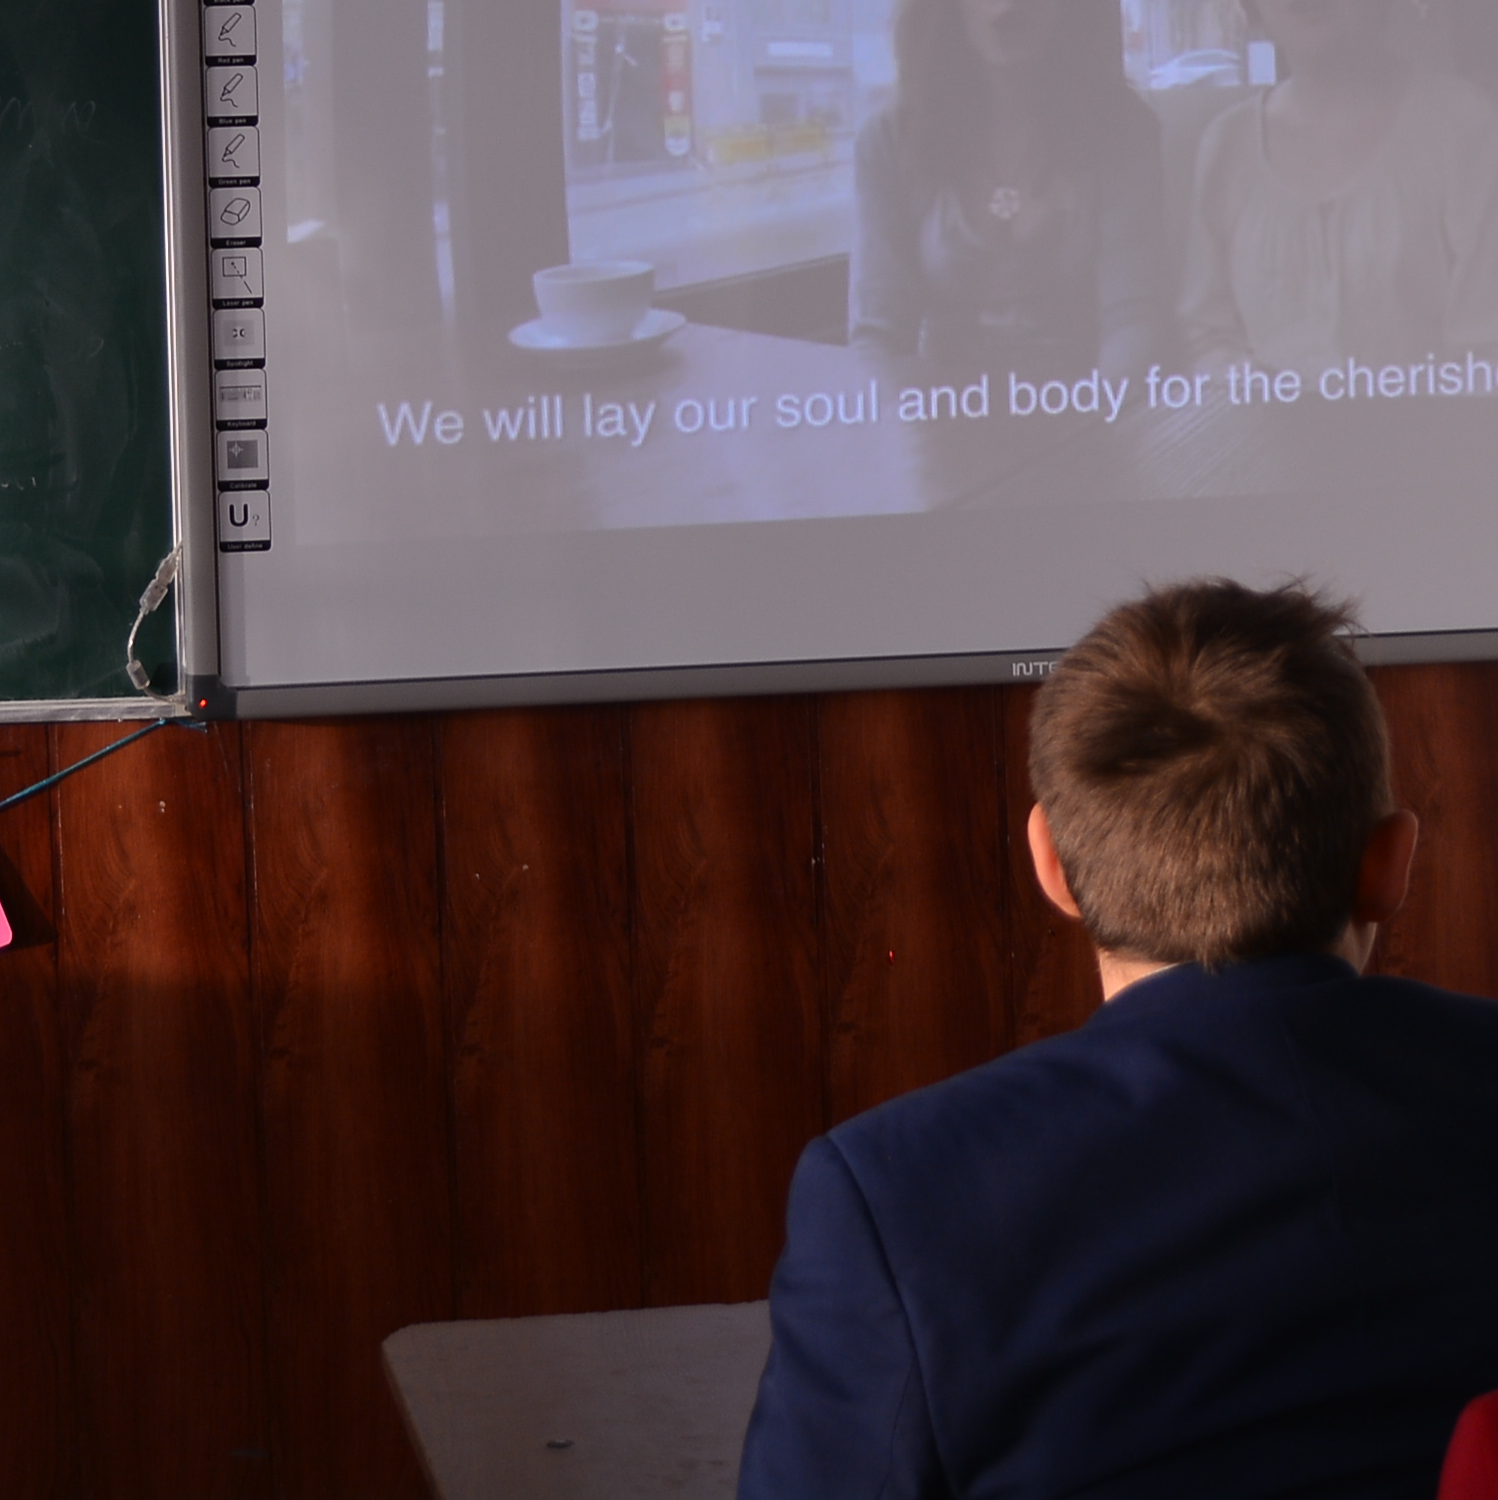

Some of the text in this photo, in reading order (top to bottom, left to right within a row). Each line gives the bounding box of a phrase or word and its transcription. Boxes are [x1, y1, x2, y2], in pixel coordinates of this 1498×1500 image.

[376, 402, 464, 446] We
[483, 394, 563, 441] will
[582, 393, 655, 447] lay
[674, 398, 756, 433] our
[776, 380, 878, 428] soul
[898, 374, 989, 421] and
[1009, 368, 1128, 423] body
[1144, 364, 1211, 409] for
[1226, 361, 1301, 405] the
